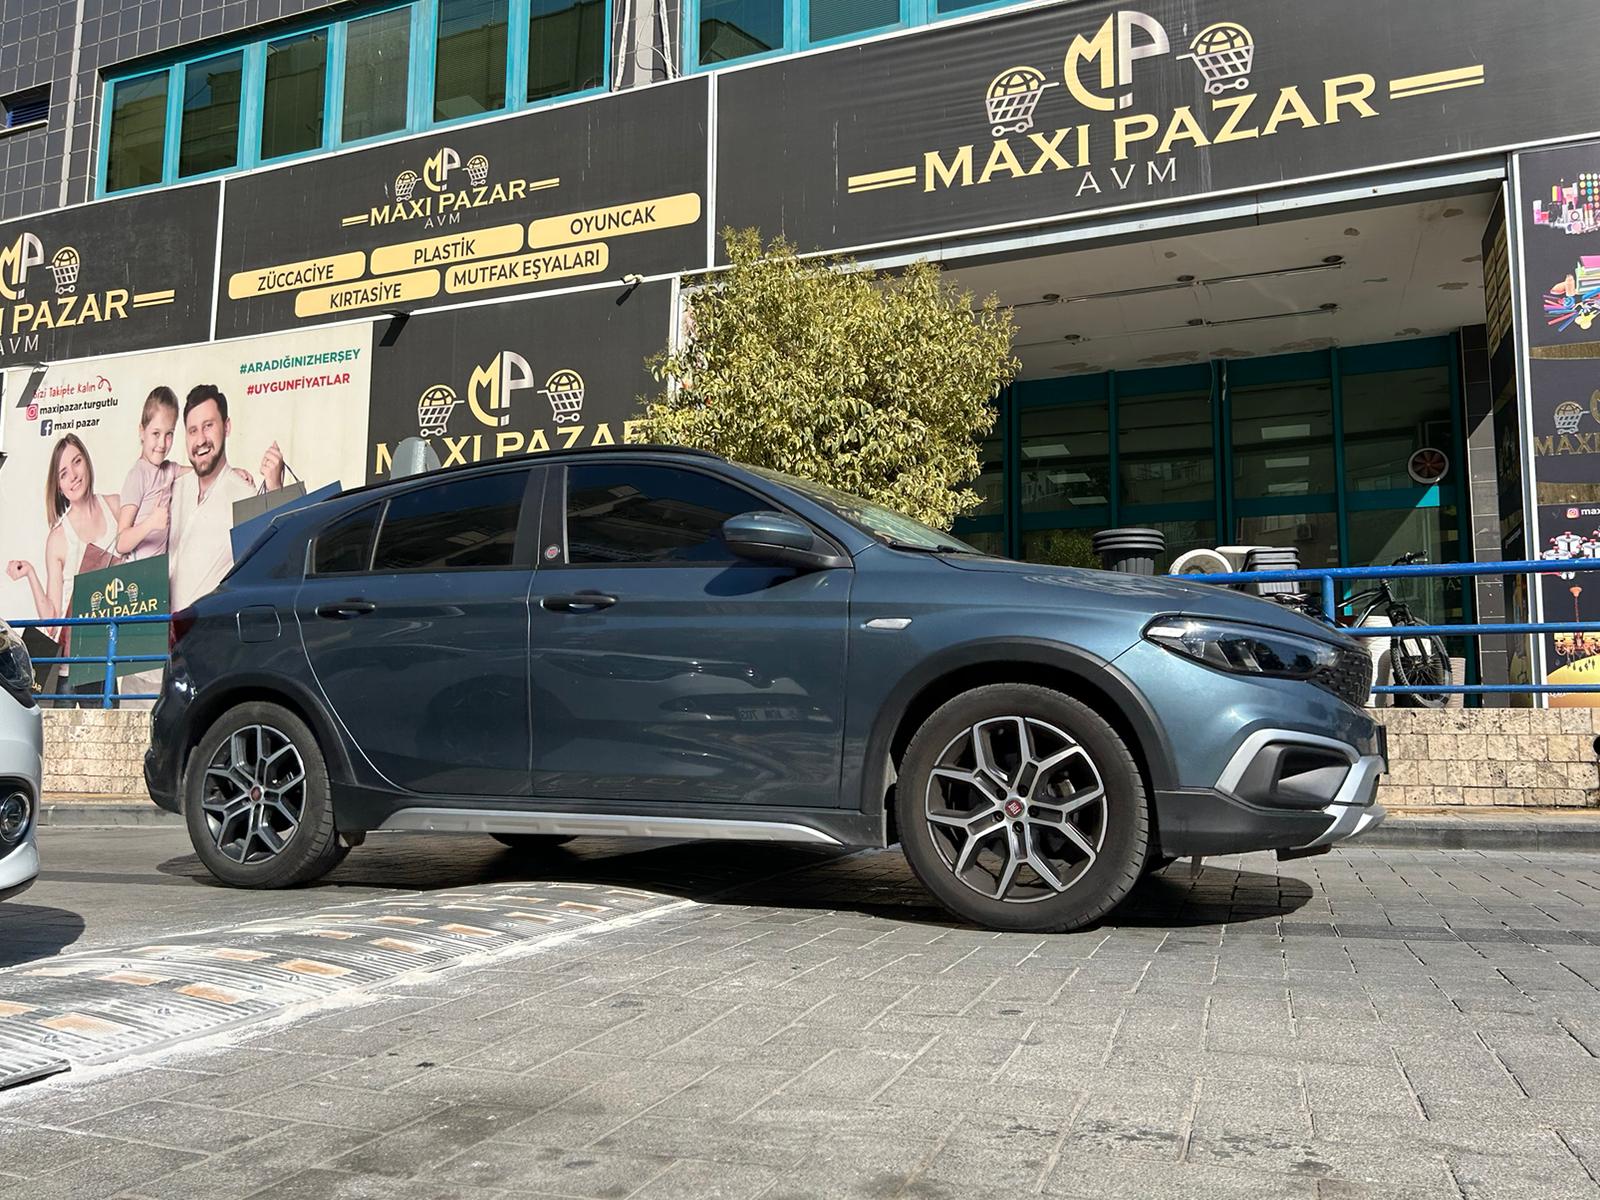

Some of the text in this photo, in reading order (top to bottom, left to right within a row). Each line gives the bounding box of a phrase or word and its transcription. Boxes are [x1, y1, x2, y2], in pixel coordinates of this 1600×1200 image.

[923, 73, 1379, 193] MAXI PAZAR
[1075, 157, 1176, 197] AVM
[370, 178, 527, 227] MAXI PAZAR
[423, 211, 461, 230] AVM
[570, 205, 656, 236] OYUNCAK
[413, 236, 476, 265] PLASTİK
[257, 263, 334, 292] ZÜCCACİYE
[453, 249, 600, 287] MUTFAK EŞYALARI
[329, 281, 402, 309] KIRTASİYE
[11, 288, 129, 336] PAZAR
[239, 348, 361, 374] #ARADIĞINIZHERŞEY
[246, 372, 350, 396] #UYGUNFİYATLAR
[39, 397, 119, 416] maxipazar.turgutlu
[54, 418, 100, 431] maxi pazar
[375, 434, 483, 475] MXI
[113, 598, 158, 617] PAZAR
